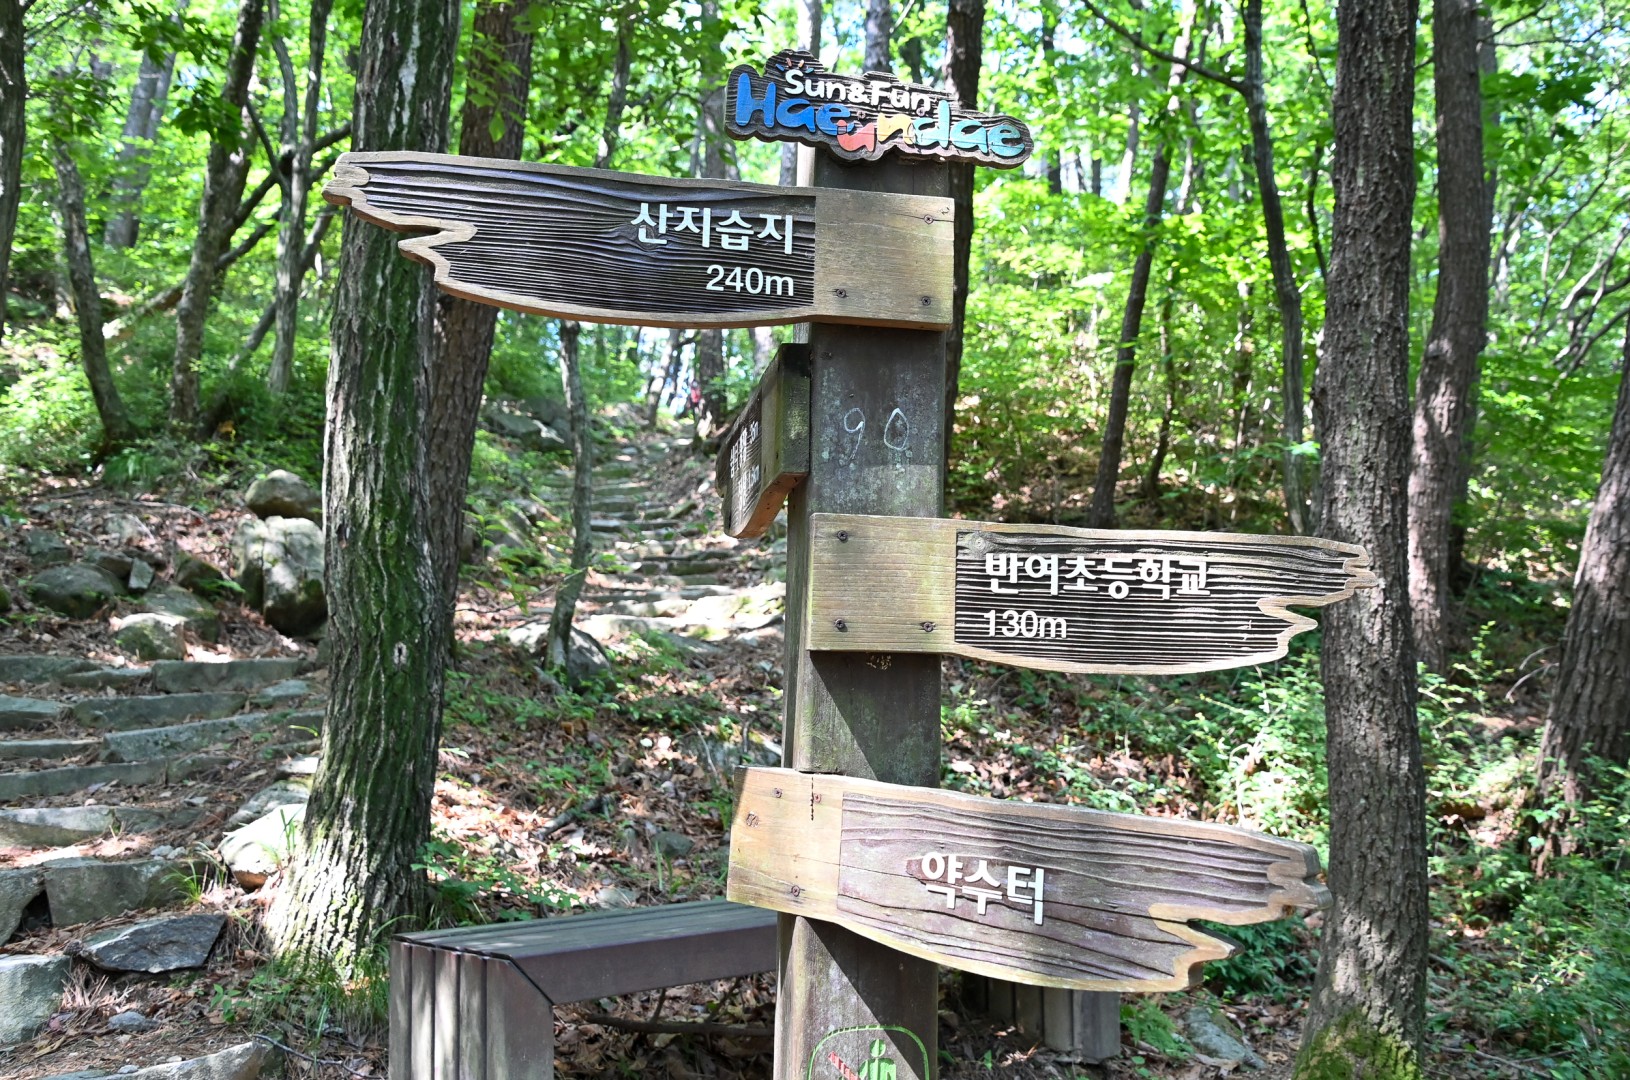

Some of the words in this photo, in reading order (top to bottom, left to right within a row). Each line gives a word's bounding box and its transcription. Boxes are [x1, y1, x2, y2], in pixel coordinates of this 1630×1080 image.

[735, 72, 1026, 157] Haeundae
[784, 69, 931, 113] Sun&Fun
[631, 202, 793, 255] 산지습지
[706, 264, 794, 297] 240m
[985, 552, 1211, 600] 반여초등학교
[983, 609, 1067, 639] 130m
[921, 851, 1045, 925] 약수터
